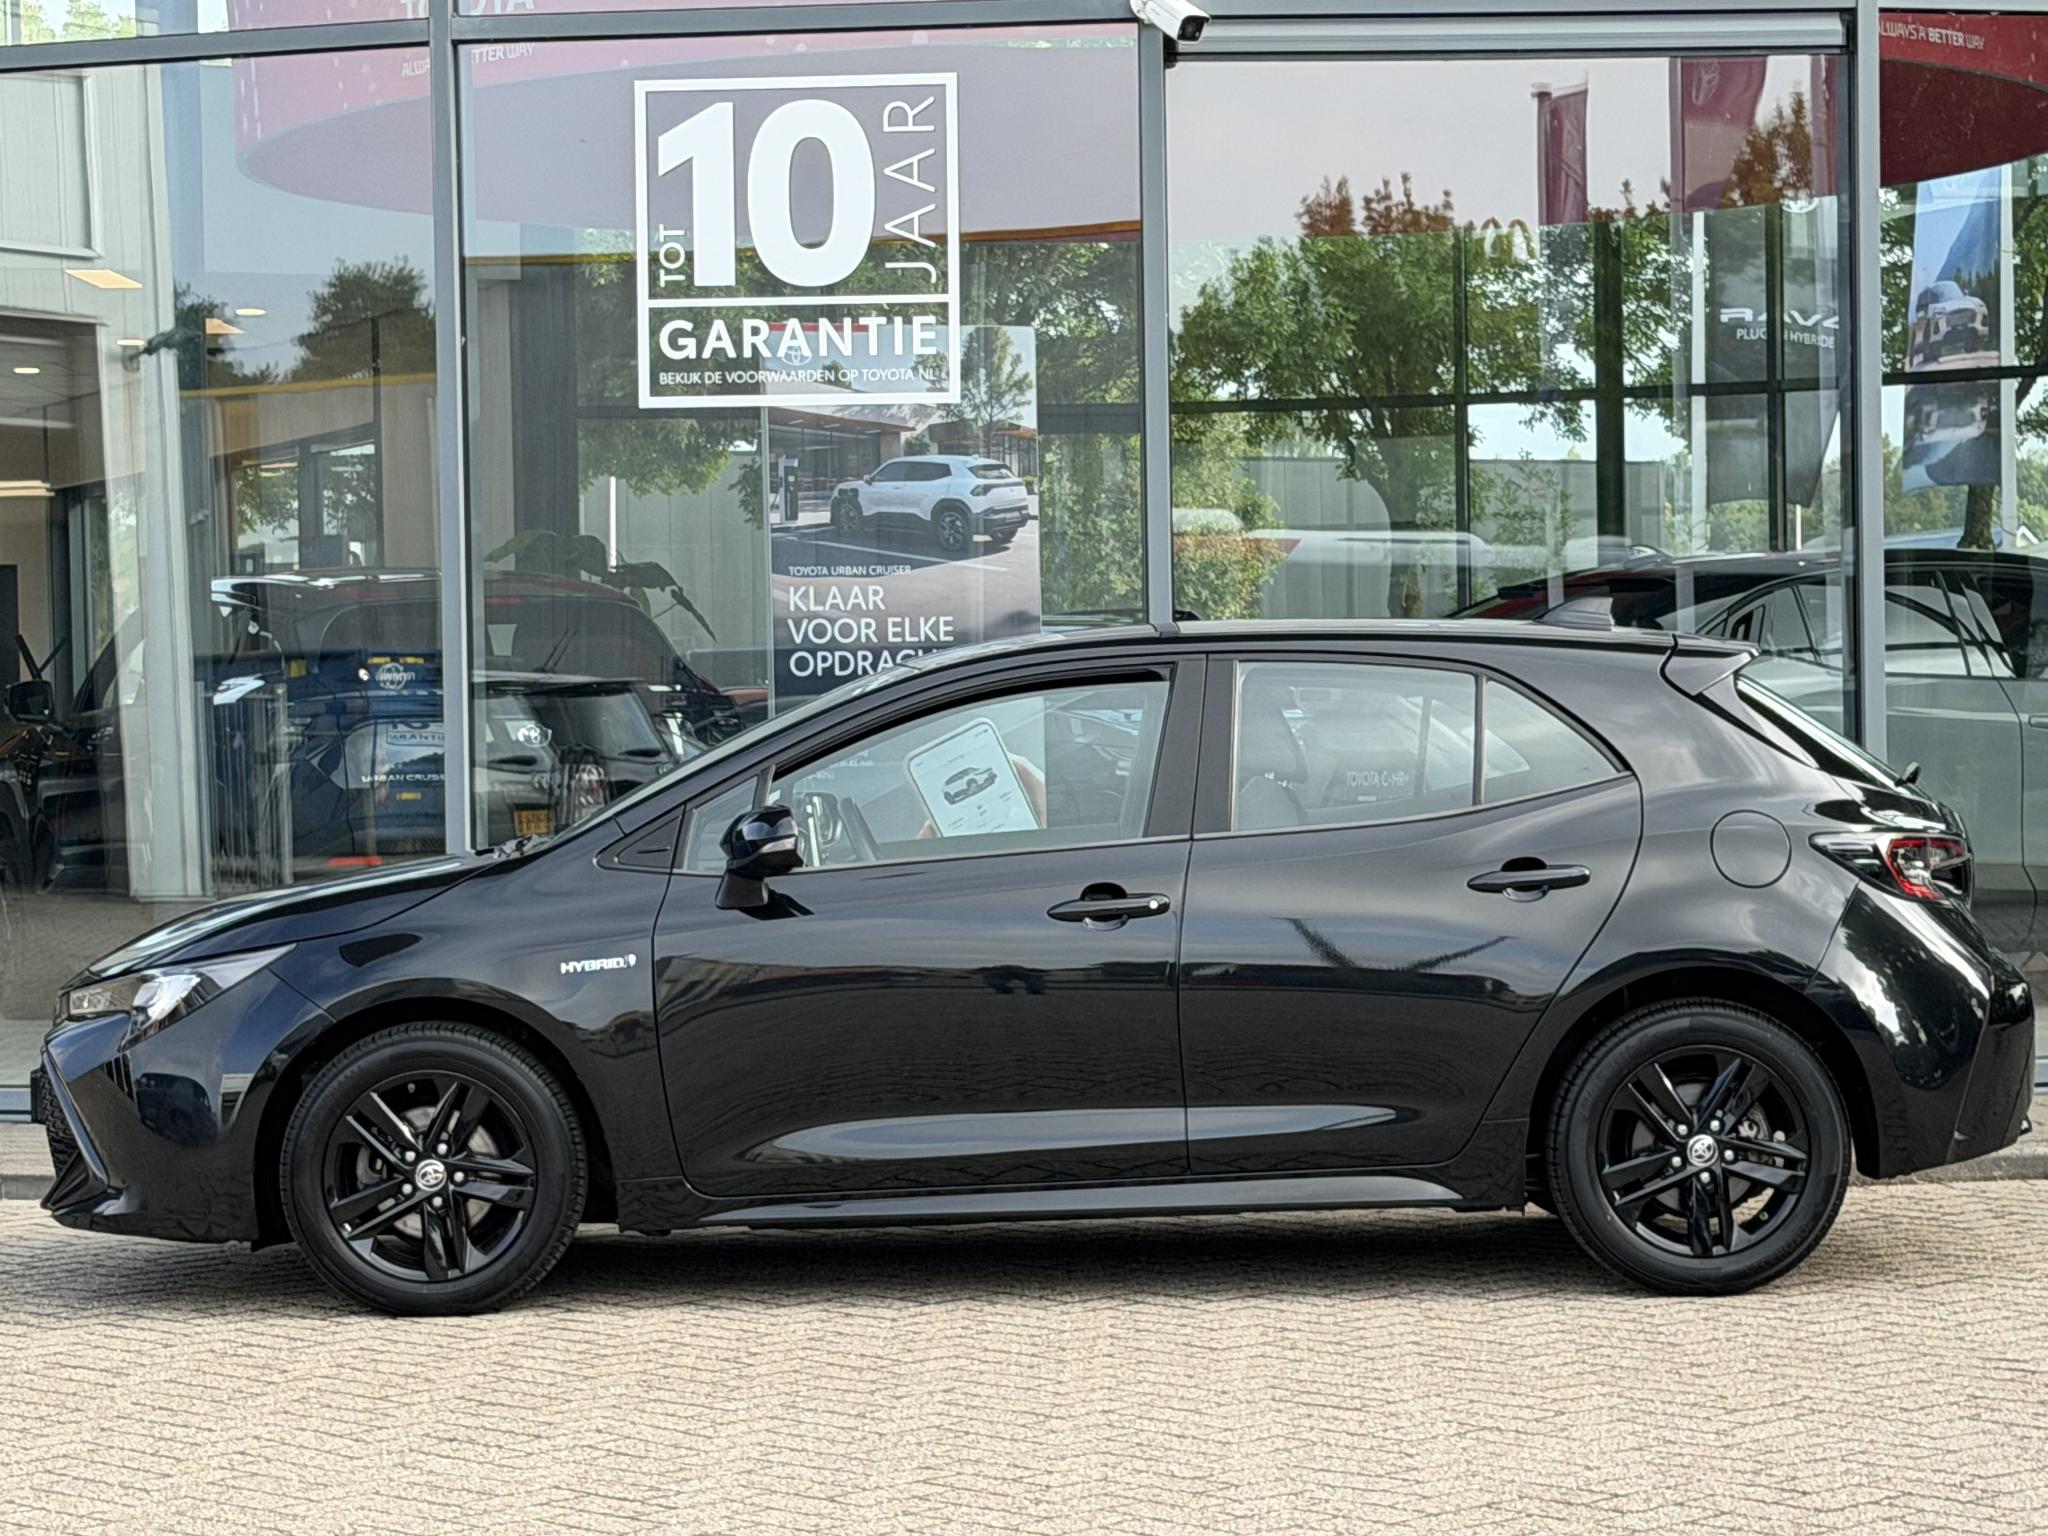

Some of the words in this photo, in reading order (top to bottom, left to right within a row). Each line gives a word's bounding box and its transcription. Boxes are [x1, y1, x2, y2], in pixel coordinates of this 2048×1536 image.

[1879, 19, 1917, 40] LWAYS
[1928, 27, 1965, 46] BETTER
[1965, 34, 1985, 49] WAY
[471, 47, 504, 64] TTER
[657, 98, 876, 288] 10
[882, 95, 937, 284] JAAR
[658, 224, 686, 288] TOT
[658, 315, 938, 361] GARANTIE
[659, 371, 702, 385] BEKIJK
[704, 371, 723, 385] DE
[724, 369, 836, 384] VOORWAARDEN
[838, 368, 860, 383] OP
[788, 566, 830, 577] TOYOTA
[831, 566, 867, 576] URBAN
[869, 565, 912, 576] CRUISER
[789, 585, 885, 612] KLAAR
[787, 617, 878, 645] VOOR
[887, 616, 955, 643] ELKE
[789, 648, 944, 678] OPDRA
[560, 957, 626, 974] HYBRID
